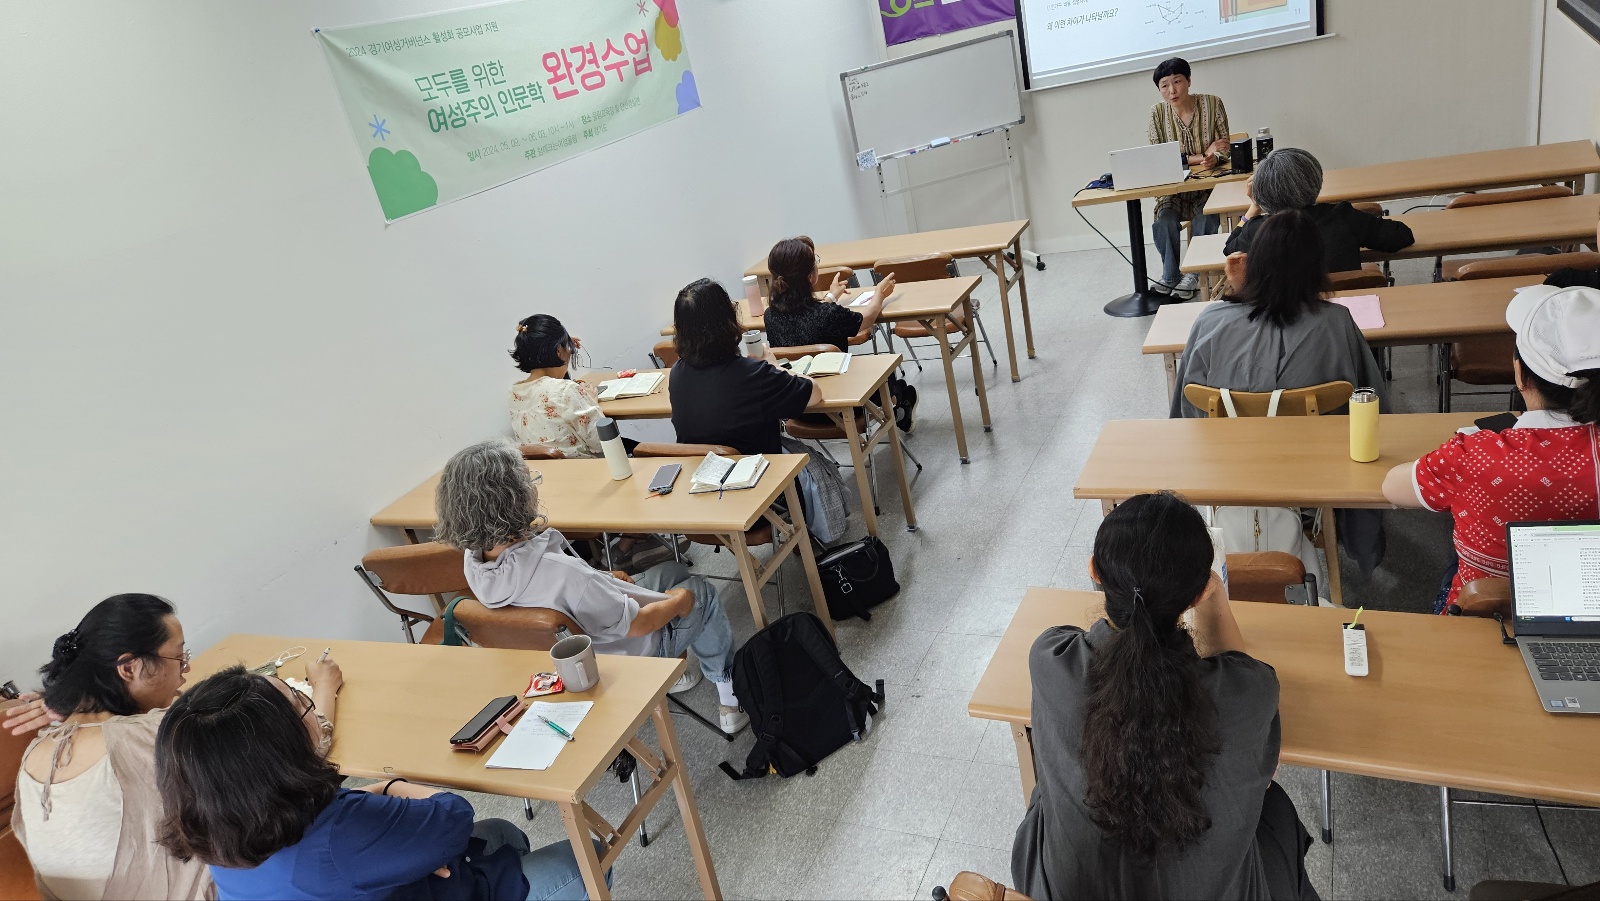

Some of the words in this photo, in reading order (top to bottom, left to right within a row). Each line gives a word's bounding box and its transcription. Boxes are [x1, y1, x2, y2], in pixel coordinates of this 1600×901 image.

[1054, 19, 1066, 29] 이런
[1066, 14, 1085, 26] 차이가
[1085, 7, 1119, 23] 나타날까요?
[345, 47, 367, 58] 2024
[367, 35, 432, 56] 경기여성거버넌스
[431, 29, 455, 44] 활성화
[455, 23, 484, 39] 공모사업
[484, 21, 499, 32] 지원
[414, 67, 471, 102] 모두를
[471, 59, 507, 89] 위한
[541, 28, 653, 101] 완경수업
[427, 93, 499, 133] 여성주의
[497, 81, 546, 115] 인문학
[581, 114, 592, 125] 장소
[467, 149, 482, 162] 일시
[565, 120, 575, 131] 1시
[524, 148, 537, 160] 주관
